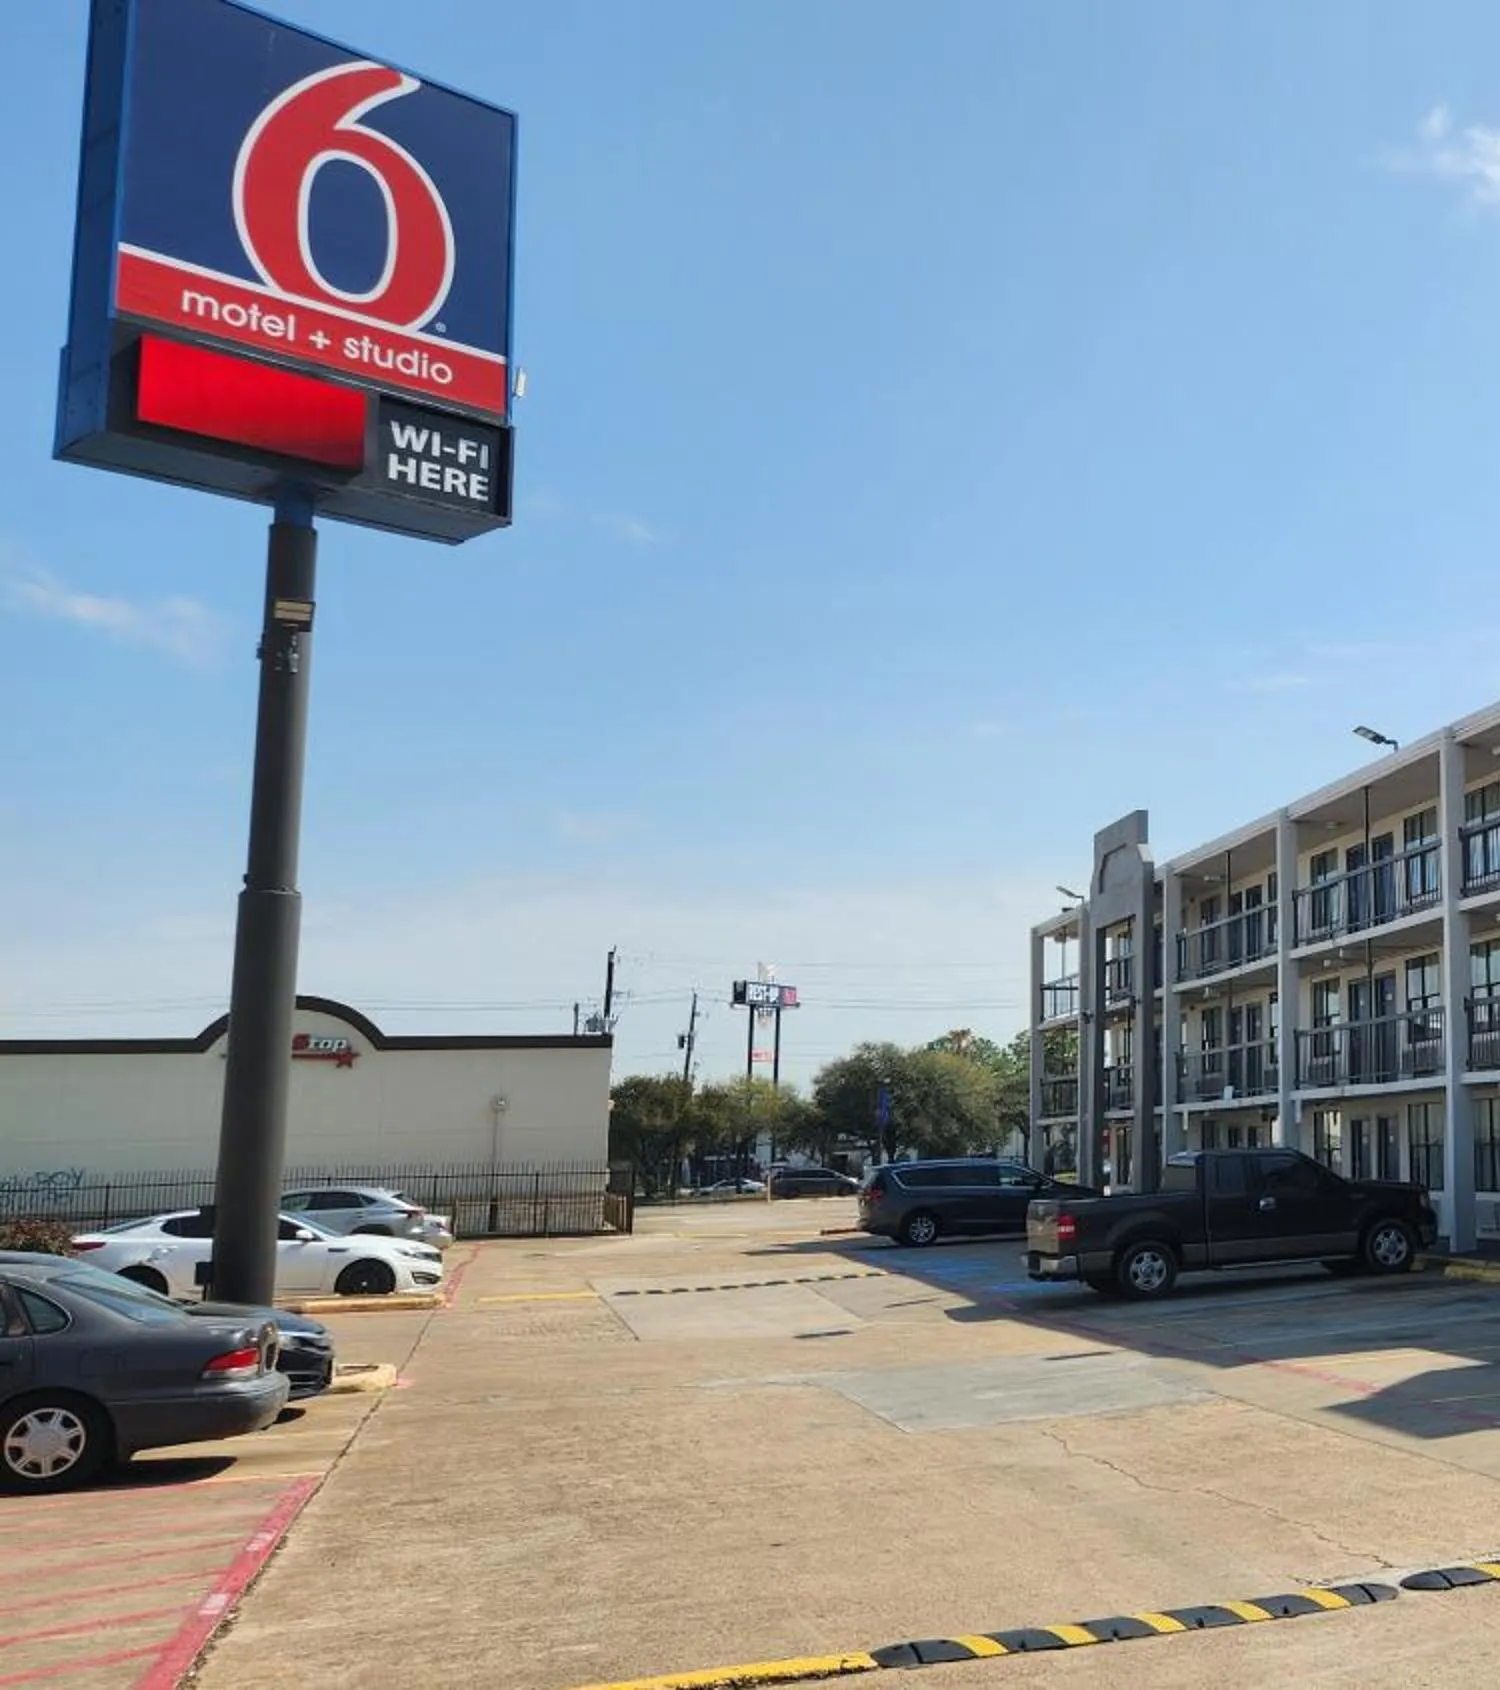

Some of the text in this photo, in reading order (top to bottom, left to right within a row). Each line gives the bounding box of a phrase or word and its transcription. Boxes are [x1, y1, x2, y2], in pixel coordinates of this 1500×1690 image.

[233, 60, 455, 332] 6
[181, 288, 296, 343] motel
[343, 334, 453, 385] studio
[388, 453, 490, 502] HERE
[391, 421, 490, 470] WI-FI
